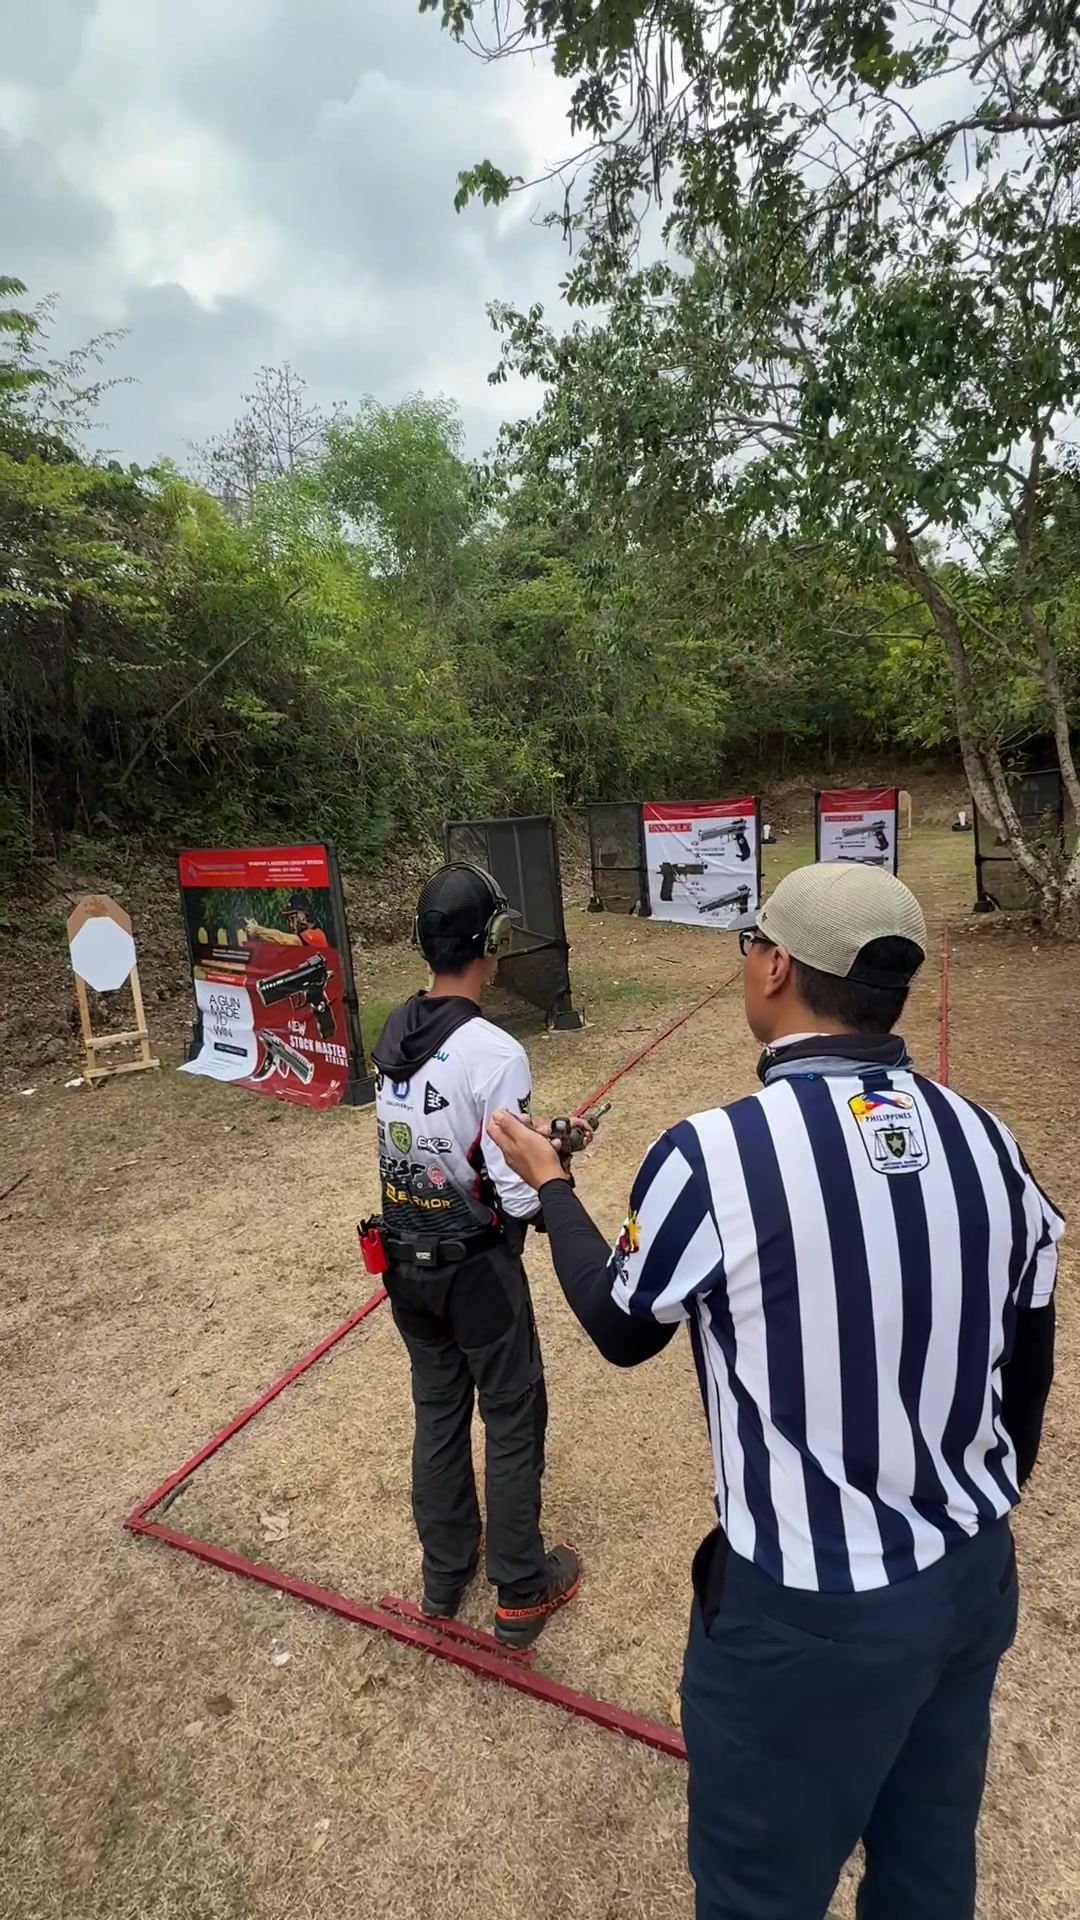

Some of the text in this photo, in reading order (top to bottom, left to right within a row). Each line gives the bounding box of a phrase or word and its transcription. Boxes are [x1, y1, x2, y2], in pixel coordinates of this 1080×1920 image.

[209, 994, 240, 1009] A GUN
[210, 1005, 240, 1019] MADE
[215, 1016, 227, 1027] TO
[288, 1018, 306, 1036] NEW
[213, 1025, 233, 1038] WIN
[289, 1035, 347, 1058] STOCK MASTER
[865, 1112, 912, 1122] PHILIPPINES
